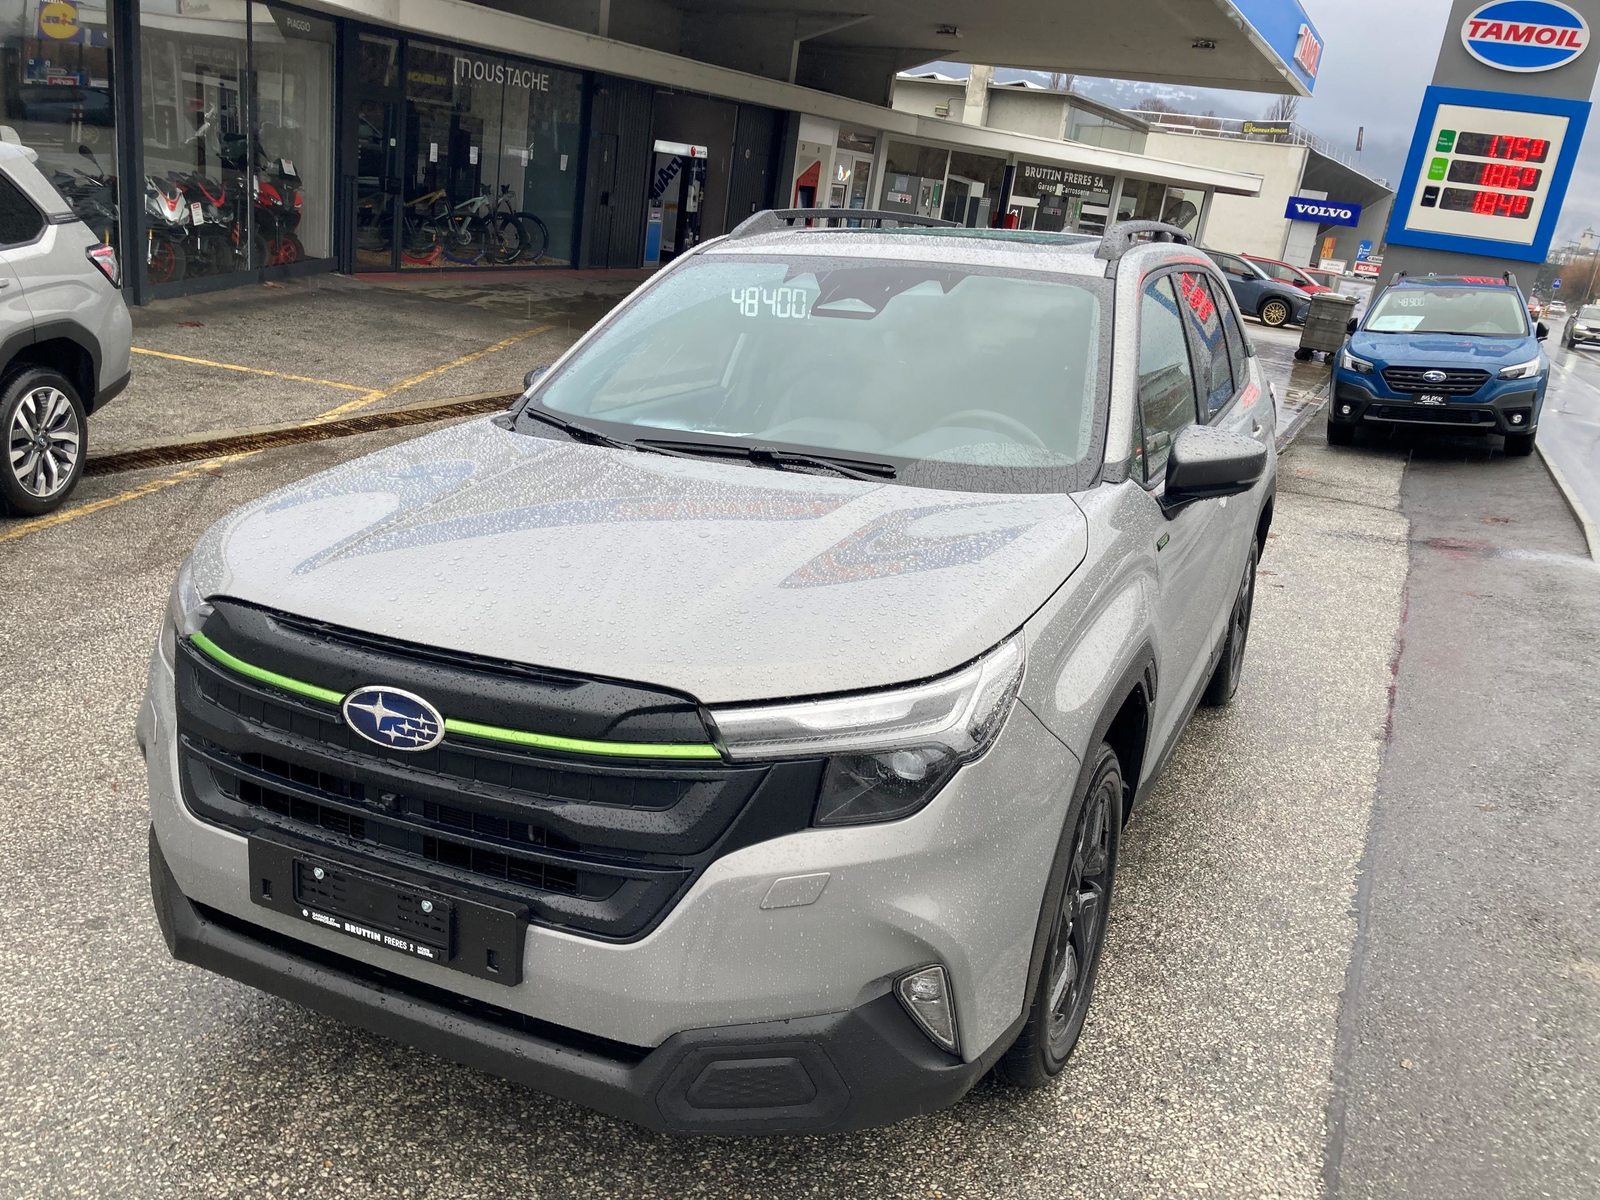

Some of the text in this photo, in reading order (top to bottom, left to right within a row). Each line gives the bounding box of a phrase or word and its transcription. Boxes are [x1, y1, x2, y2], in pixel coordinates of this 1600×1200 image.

[287, 17, 311, 32] PIAGGIO
[1468, 20, 1583, 48] TAMOIL
[1025, 166, 1104, 188] BRUTTIN FRERES SA
[1038, 182, 1056, 193] Garage
[1295, 203, 1352, 219] VOLVO
[1358, 264, 1377, 272] aprilia
[344, 922, 381, 942] BRUTTIN
[384, 935, 408, 951] FRERES
